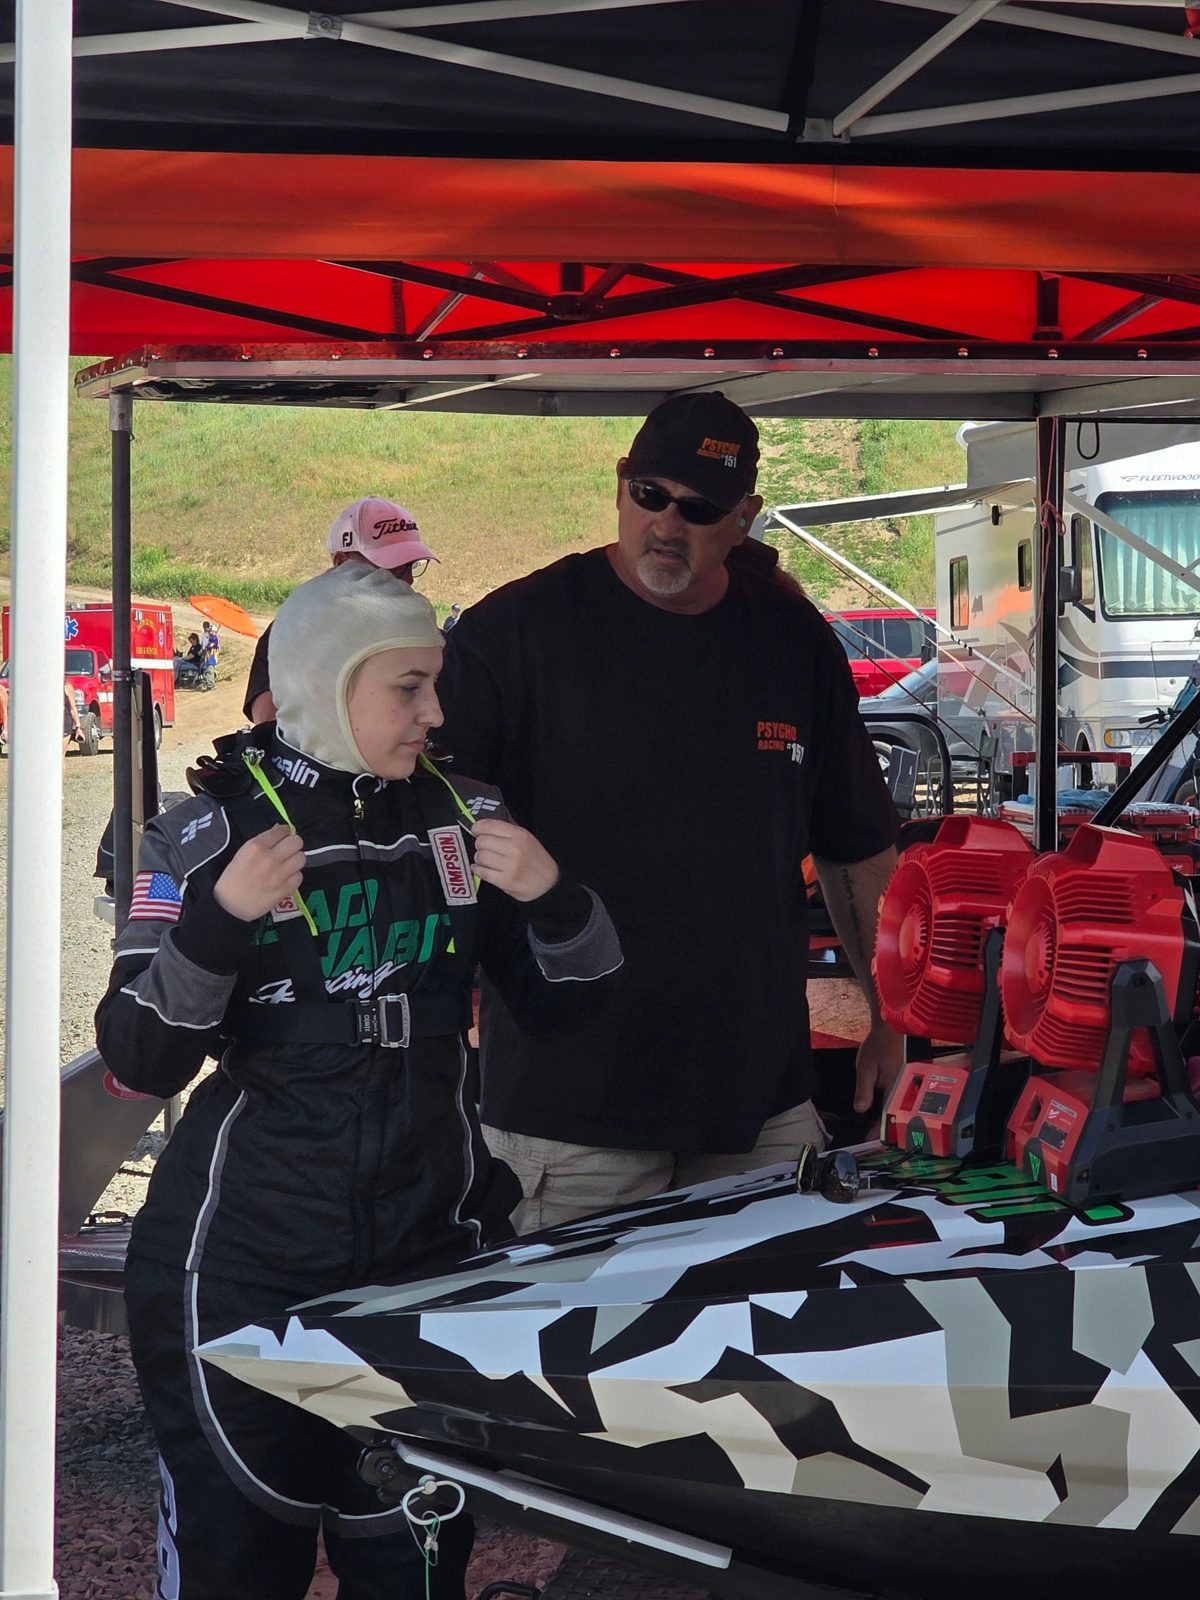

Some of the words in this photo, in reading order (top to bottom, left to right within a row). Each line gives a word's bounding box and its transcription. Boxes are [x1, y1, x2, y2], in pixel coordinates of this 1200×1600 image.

[1140, 473, 1200, 482] FLEETWOOD
[342, 531, 353, 548] FJ
[757, 721, 797, 741] PSYCHO
[439, 836, 467, 895] SIMPSON
